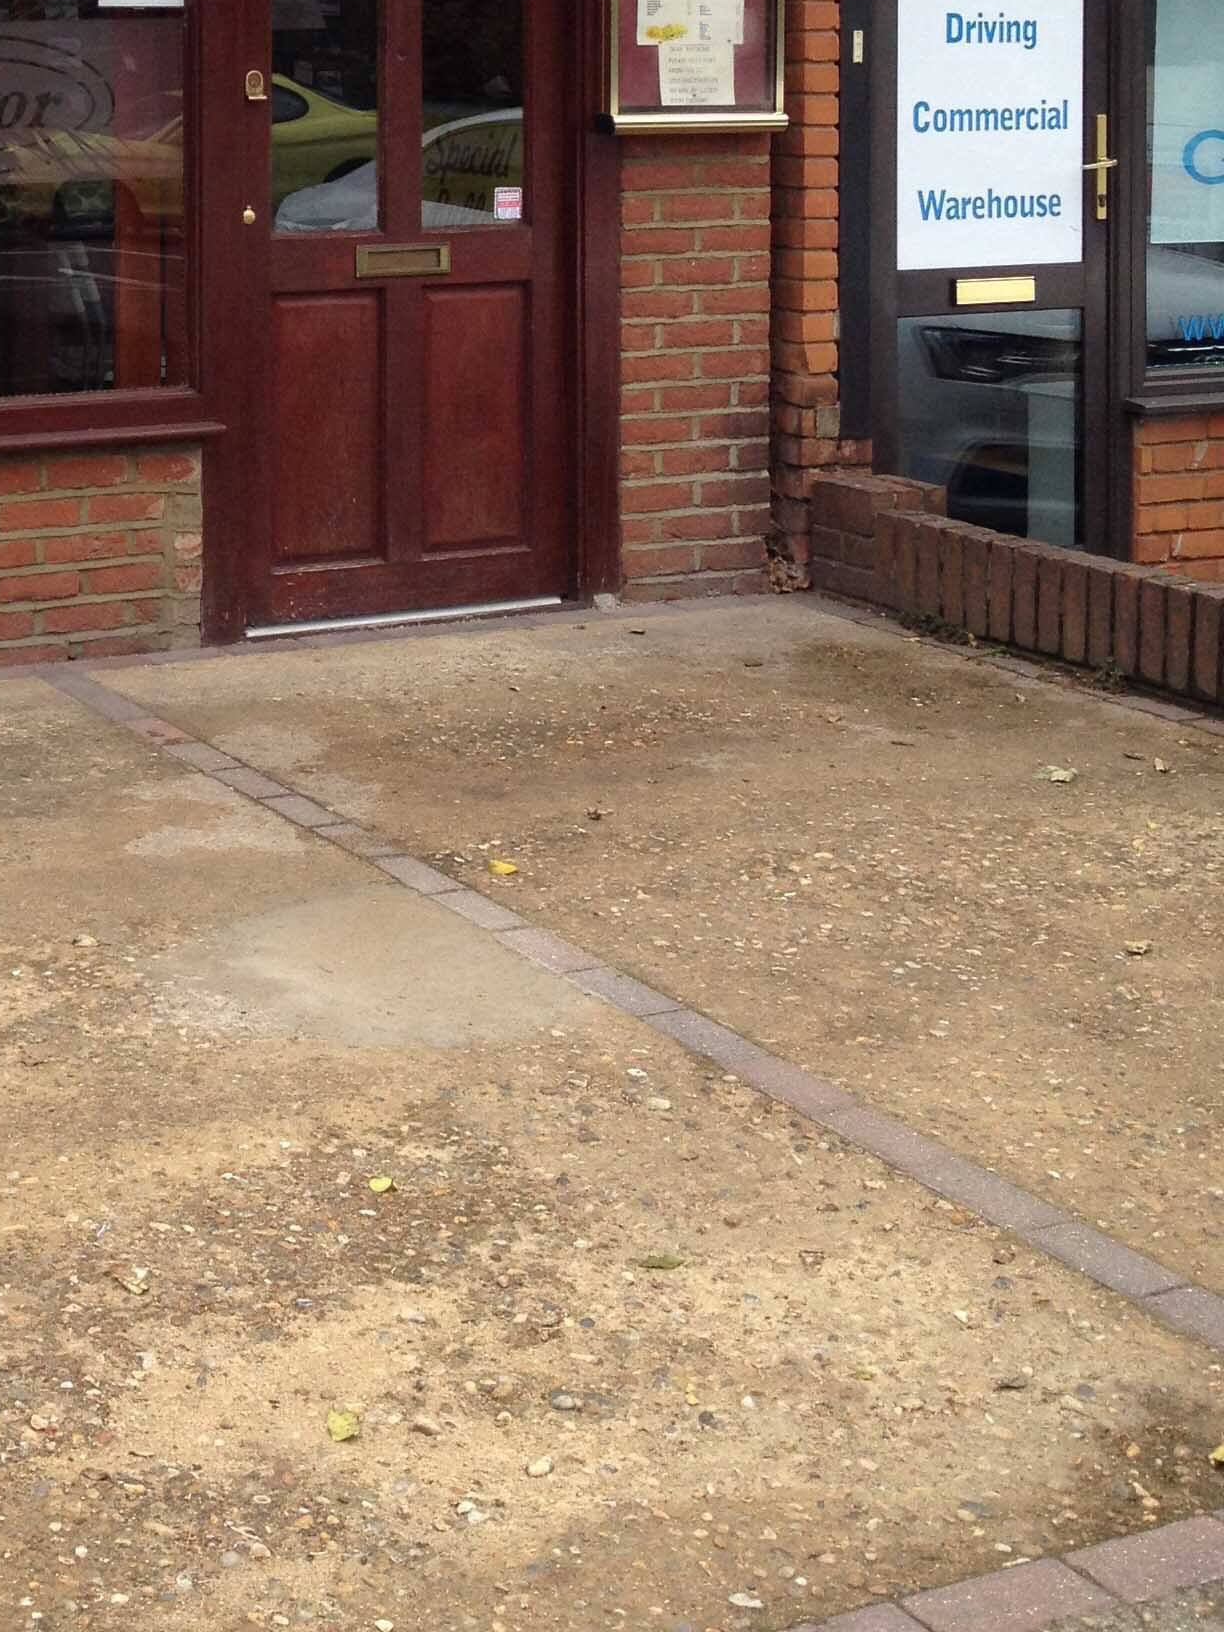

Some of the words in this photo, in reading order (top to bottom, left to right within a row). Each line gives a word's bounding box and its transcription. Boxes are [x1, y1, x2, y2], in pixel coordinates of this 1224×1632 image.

[945, 11, 1038, 50] Driving
[912, 99, 1069, 134] Commercial
[917, 188, 1062, 221] Warehouse
